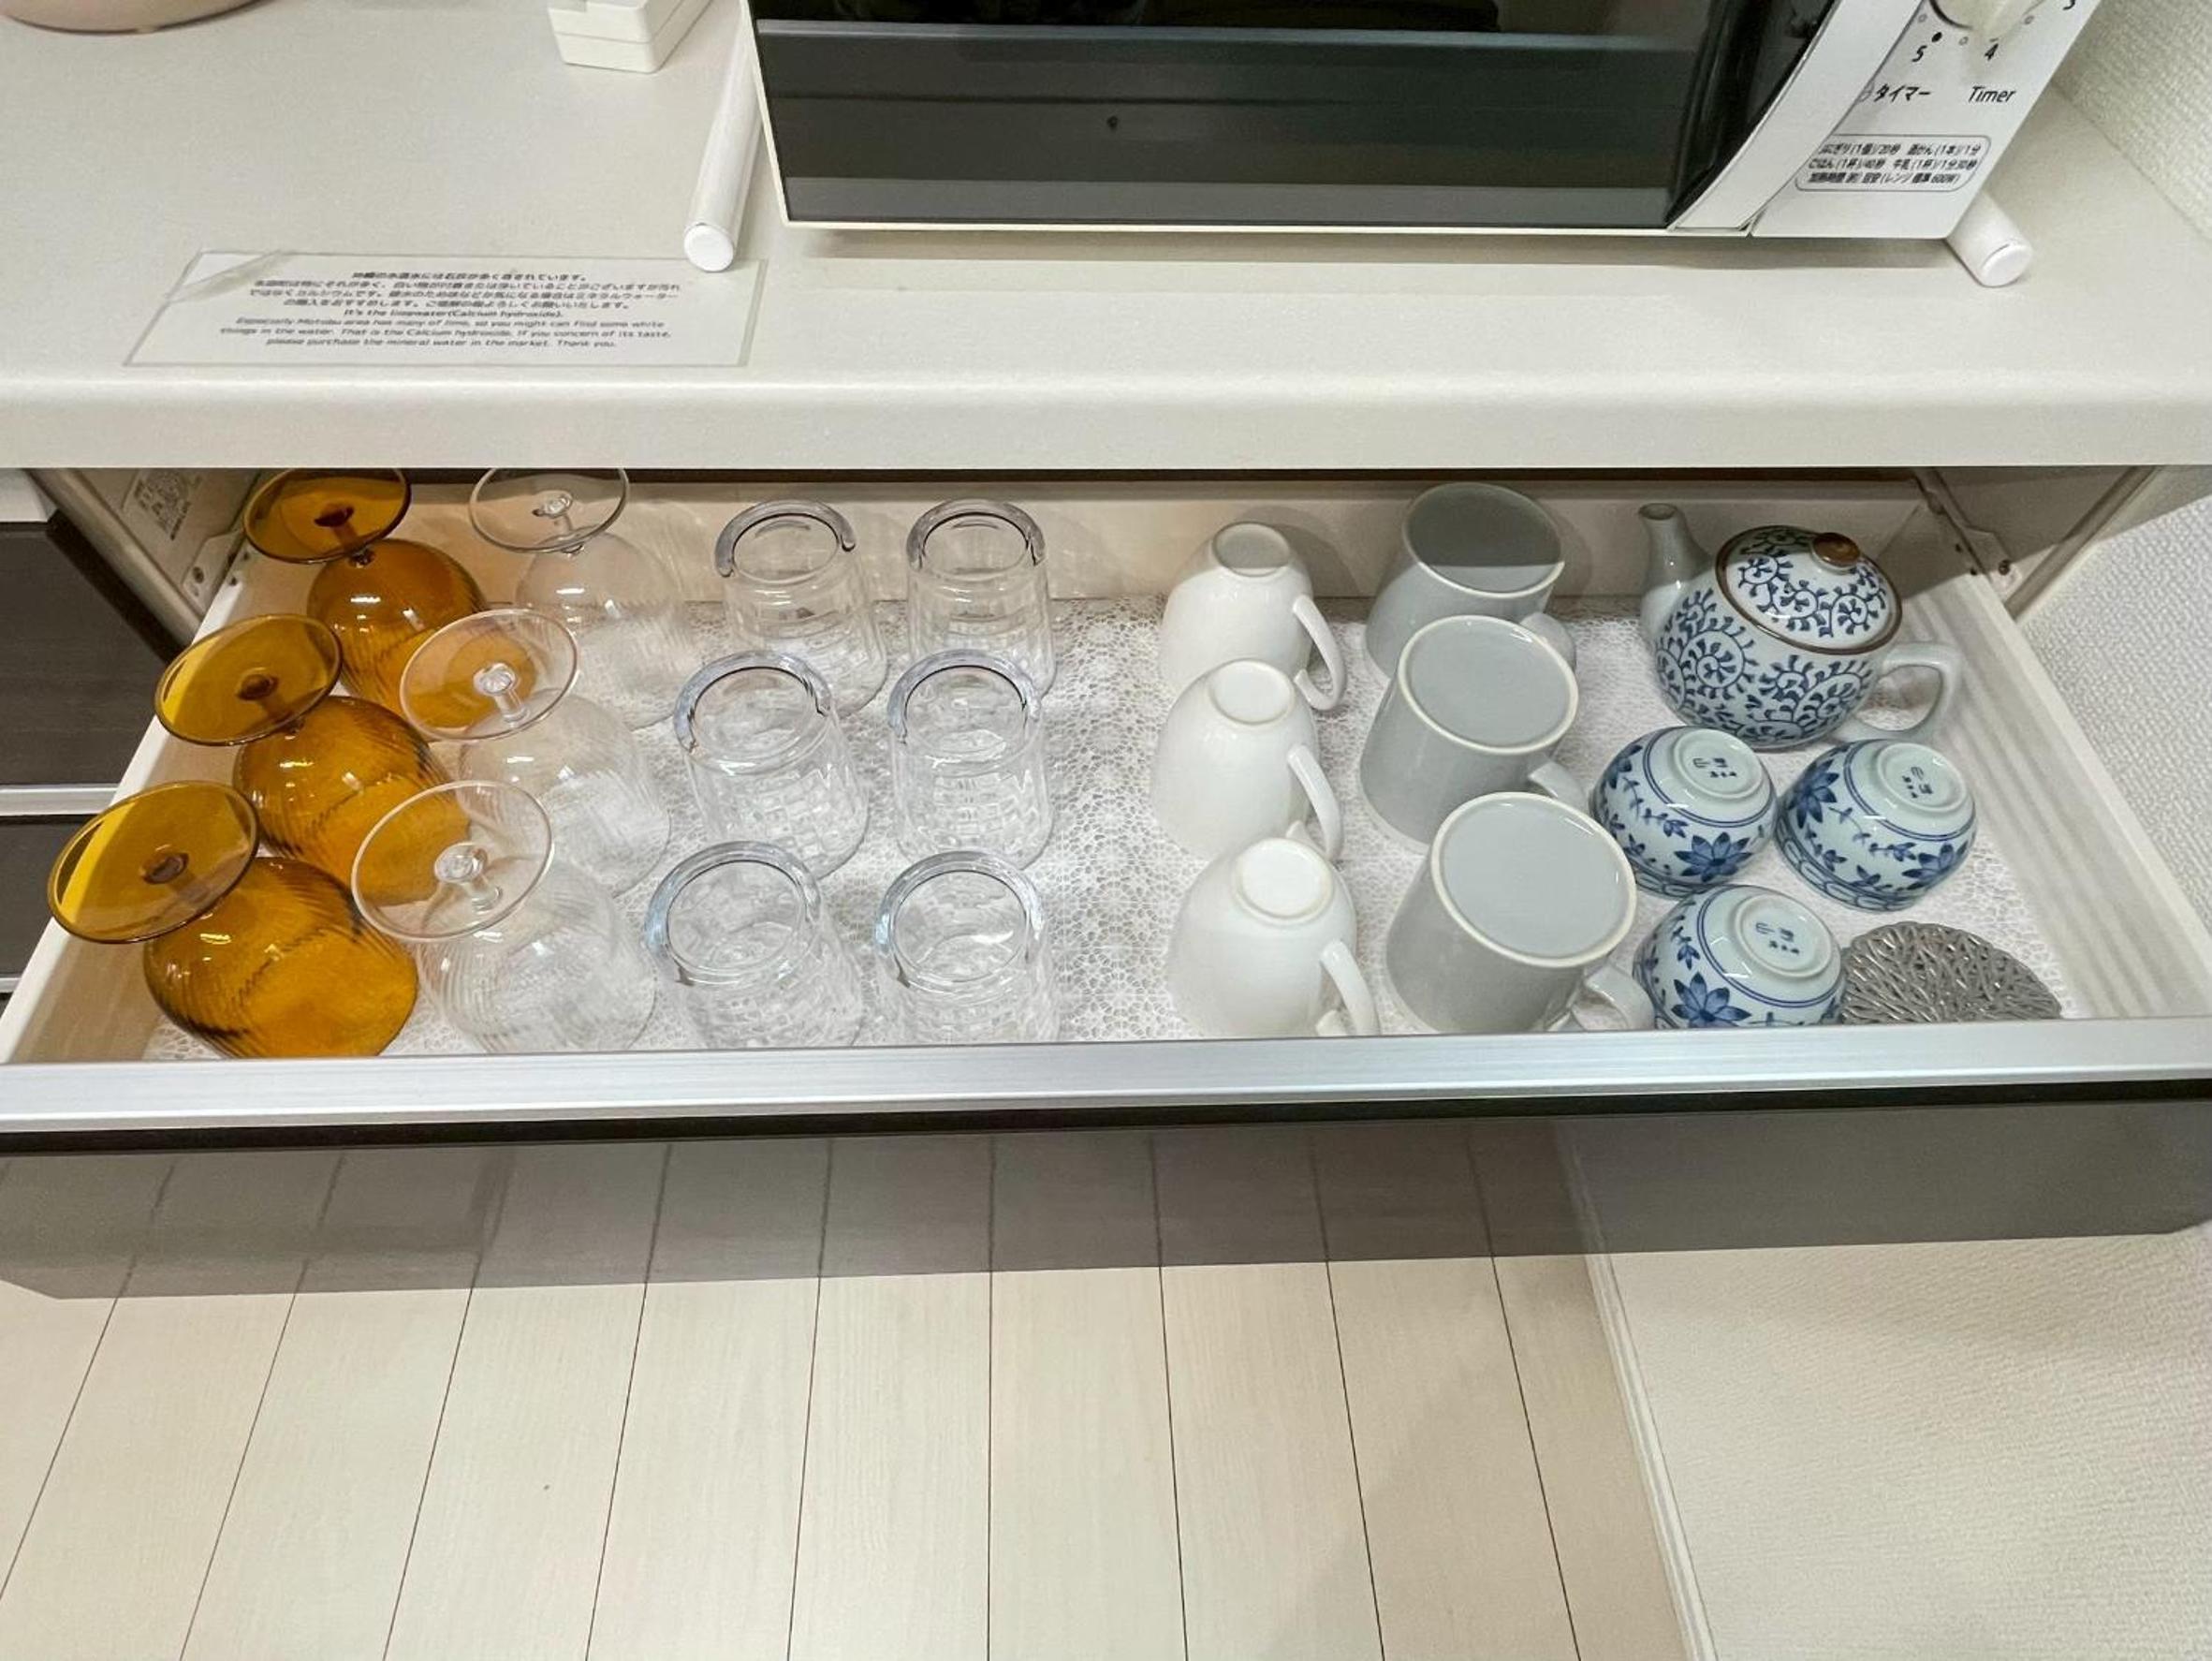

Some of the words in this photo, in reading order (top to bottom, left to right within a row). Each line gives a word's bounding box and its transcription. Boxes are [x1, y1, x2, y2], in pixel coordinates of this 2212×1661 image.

[1911, 44, 1927, 63] 5
[1984, 42, 2000, 61] 4
[1874, 83, 1932, 102] タイマー
[1967, 86, 2016, 103] Timer
[221, 327, 257, 335] things
[340, 328, 368, 336] That
